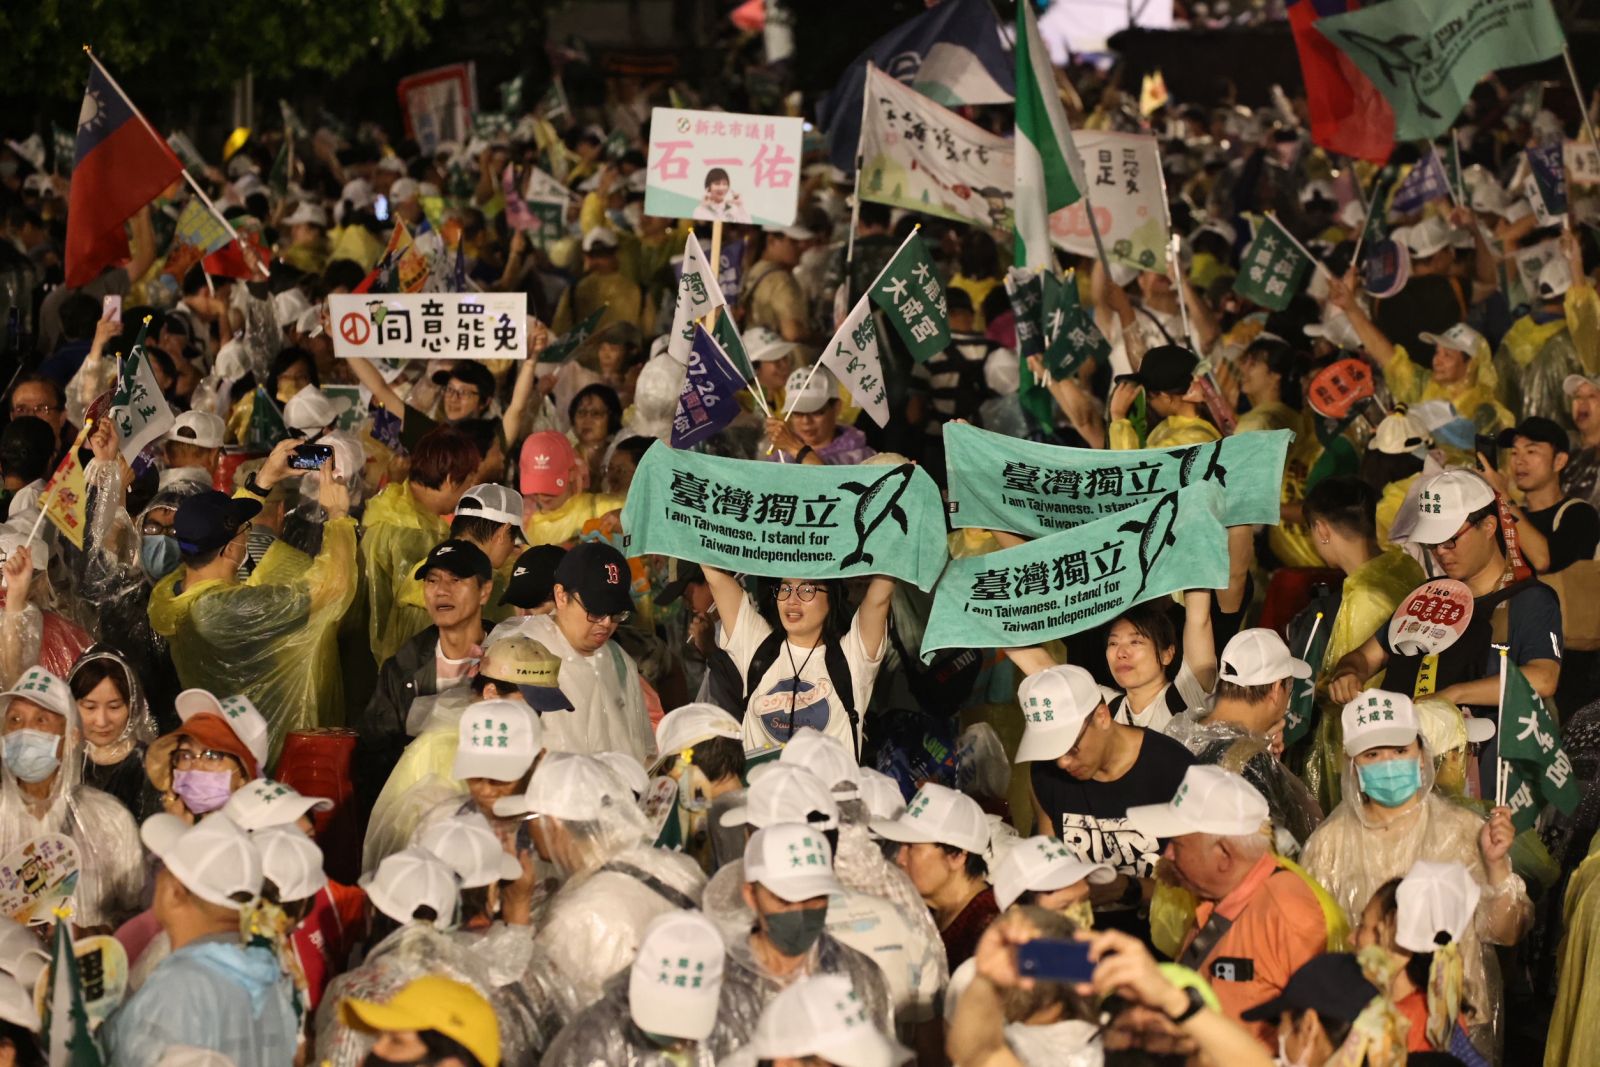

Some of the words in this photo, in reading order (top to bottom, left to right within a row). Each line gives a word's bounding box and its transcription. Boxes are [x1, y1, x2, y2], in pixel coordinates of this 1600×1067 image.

[695, 117, 776, 141] 新北市議員
[651, 141, 795, 189] 石一佑
[375, 299, 518, 352] 同意罷免
[881, 277, 940, 344] 大成宮
[1002, 460, 1166, 499] 臺灣獨立
[670, 468, 842, 528] 臺灣獨立
[1009, 498, 1026, 508] am
[1026, 499, 1094, 515] Taiwanese.
[665, 507, 669, 519] I
[673, 512, 692, 526] am
[693, 515, 756, 542] Taiwanese.
[761, 530, 766, 544] I
[766, 529, 806, 545] stand
[810, 533, 830, 546] for
[700, 534, 740, 558] Taiwan
[742, 544, 836, 562] Independence.
[604, 563, 620, 584] B
[970, 540, 1127, 600] 臺灣獨立
[964, 602, 969, 613] I
[971, 606, 992, 617] am
[996, 601, 1061, 618] Taiwanese.
[1064, 594, 1070, 606] I
[1070, 585, 1101, 606] stand
[1104, 579, 1120, 594] for
[1002, 619, 1045, 632] Taiwan
[1047, 597, 1125, 628] Independence.
[516, 668, 552, 676] TAIWAN
[1026, 710, 1054, 722] 大成宮
[1356, 698, 1392, 714] 大罷免
[1357, 710, 1394, 726] 大成宮
